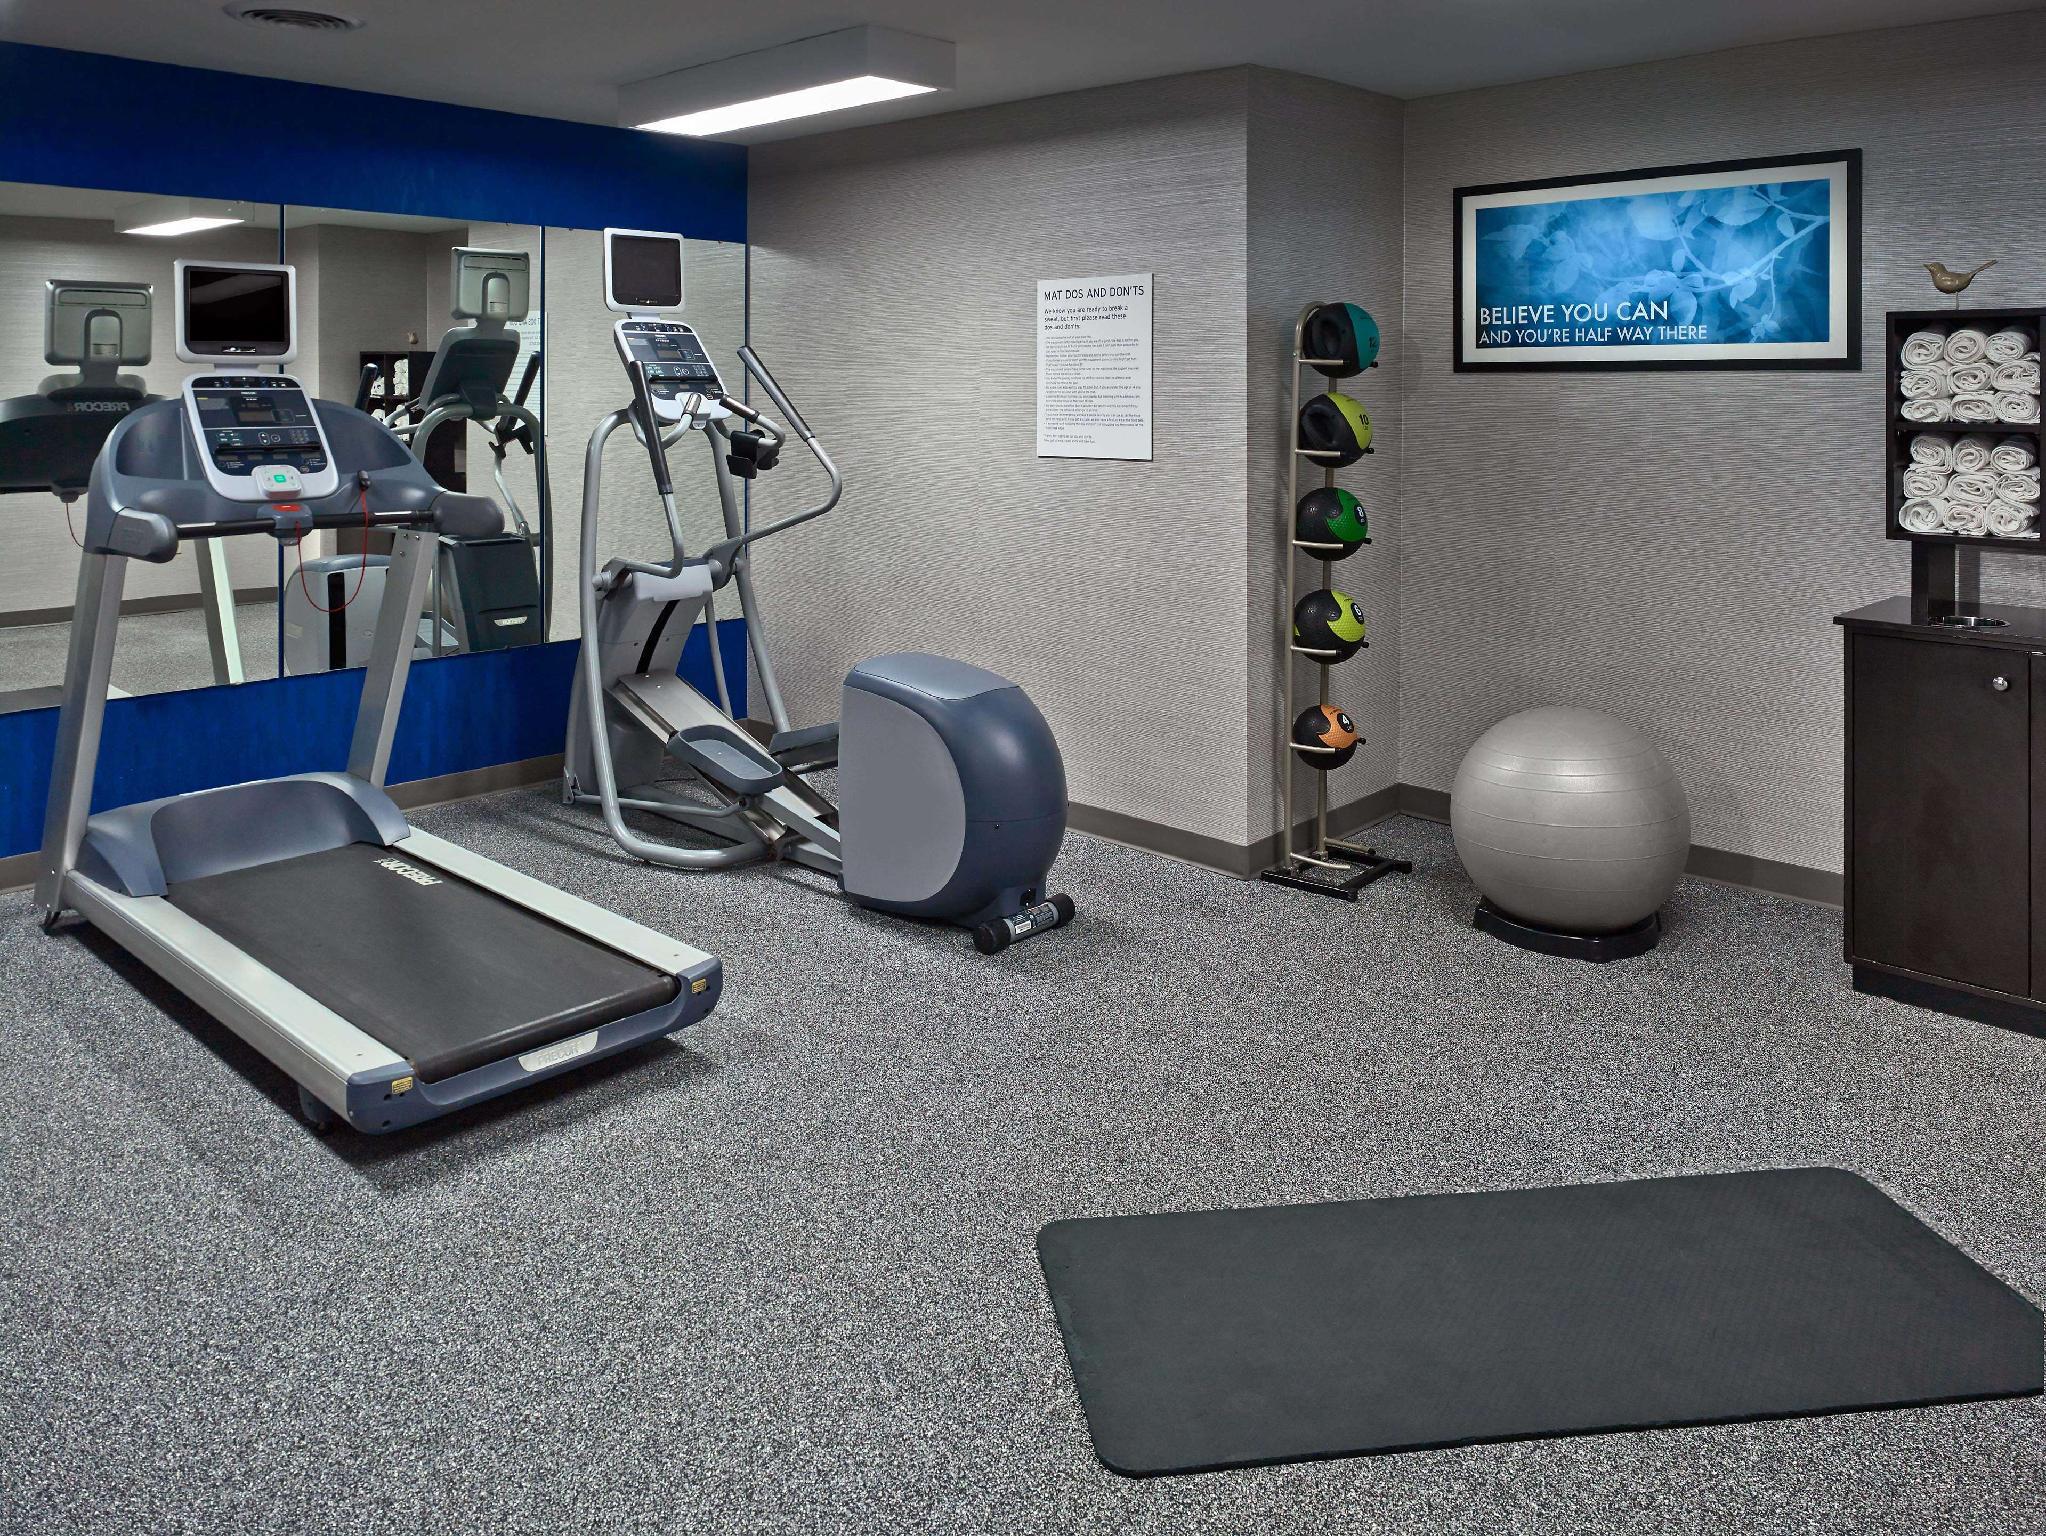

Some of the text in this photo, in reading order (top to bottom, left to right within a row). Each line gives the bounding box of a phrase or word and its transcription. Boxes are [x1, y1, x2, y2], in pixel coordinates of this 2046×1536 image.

[1044, 285, 1145, 300] MAT DOS AND DON'TS
[1480, 300, 1668, 325] BELIEVE YOU CAN
[1479, 325, 1708, 344] AND YOU'RE HALF WAY THERE
[1359, 413, 1369, 426] 10
[1356, 506, 1364, 517] 8
[1342, 714, 1350, 725] 4
